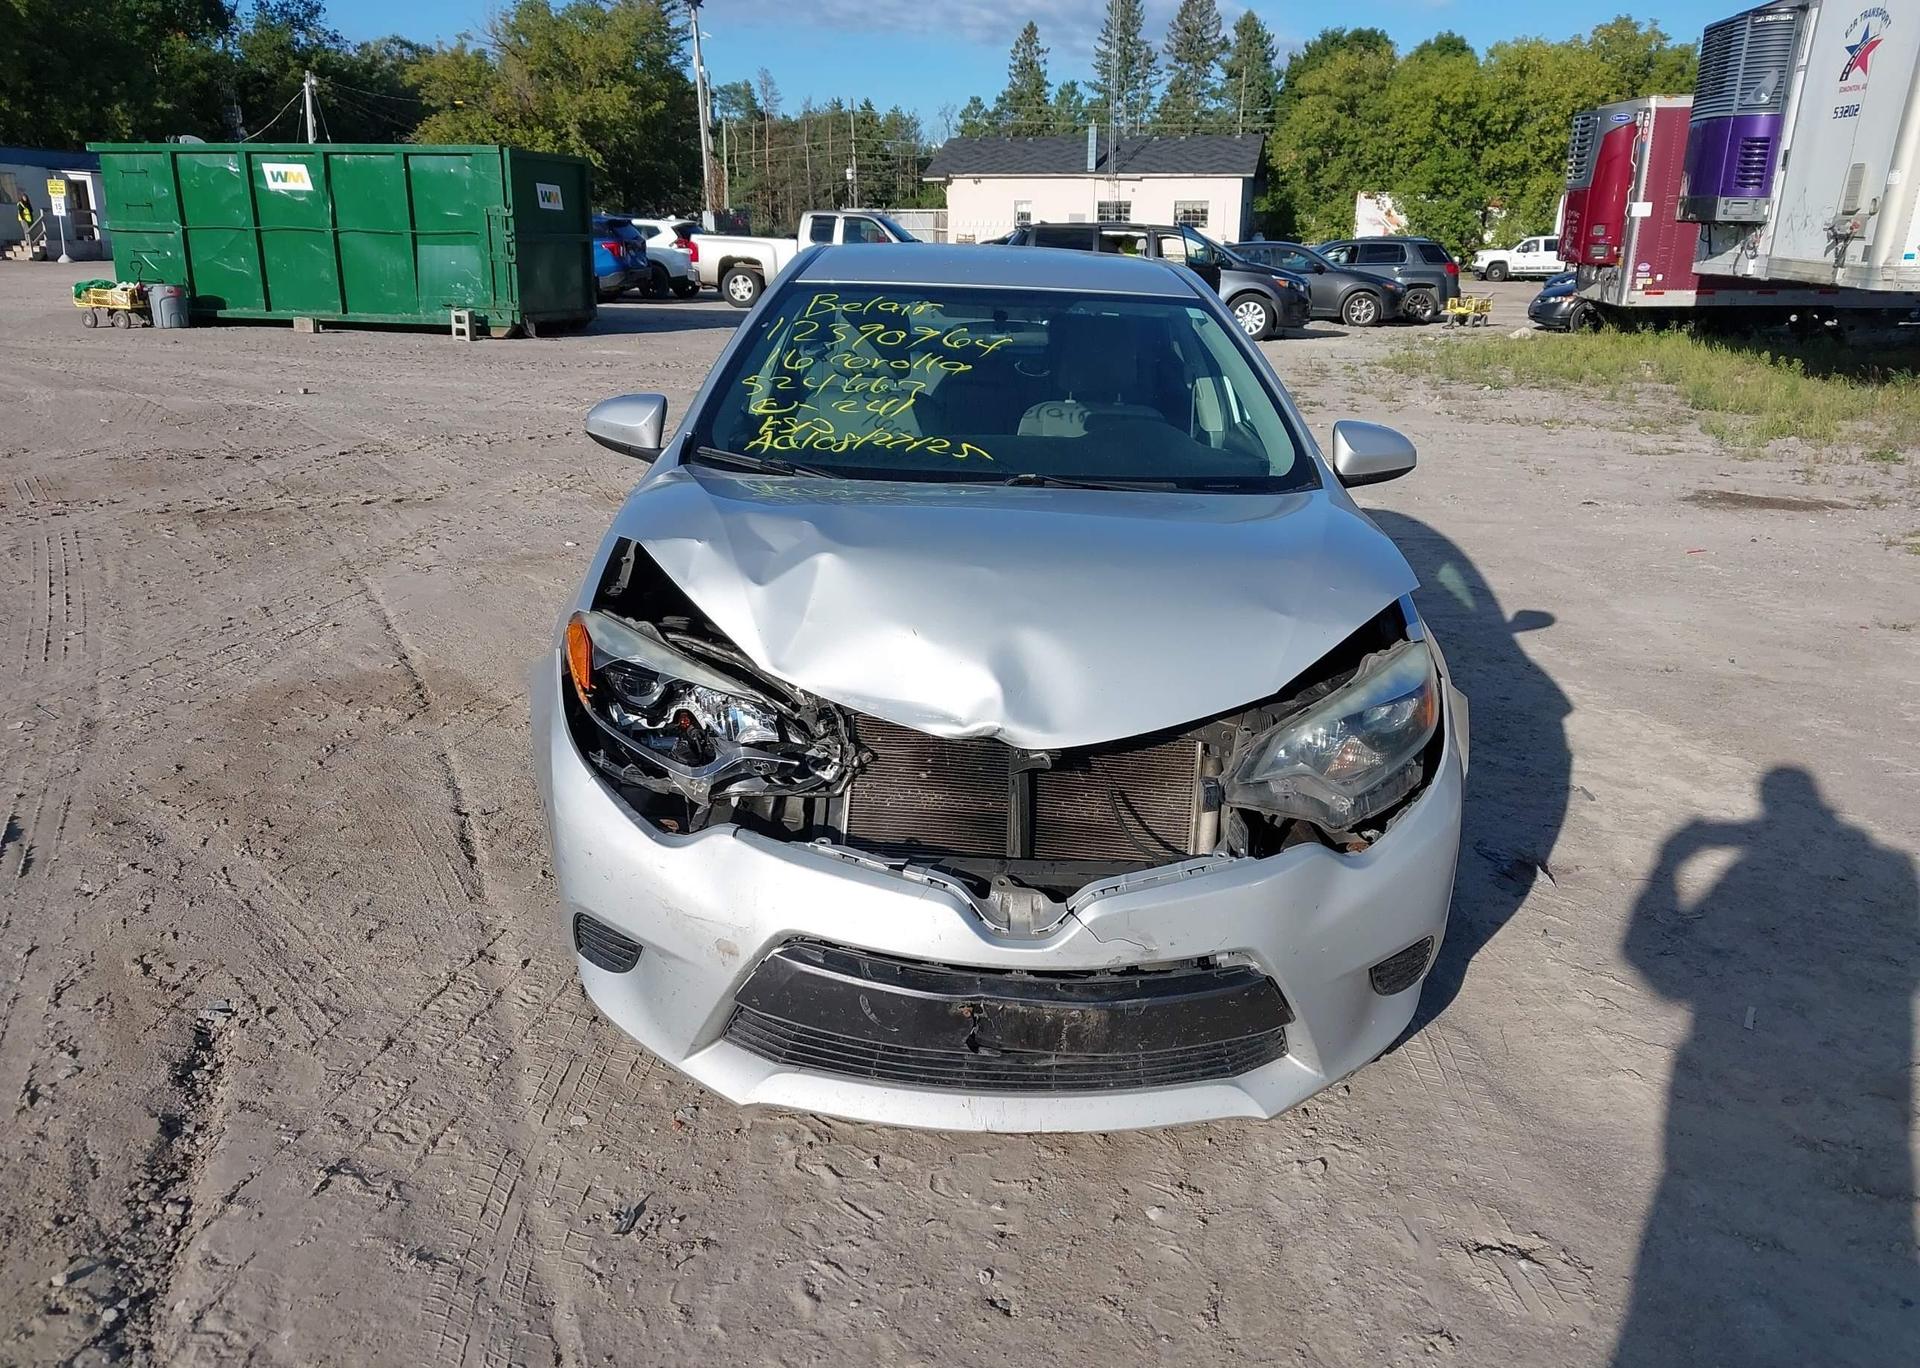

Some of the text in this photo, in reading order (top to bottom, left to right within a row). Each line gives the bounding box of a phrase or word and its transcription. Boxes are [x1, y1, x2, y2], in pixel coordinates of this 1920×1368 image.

[1832, 103, 1860, 119] 53202
[269, 170, 305, 183] WM
[540, 189, 560, 204] WM
